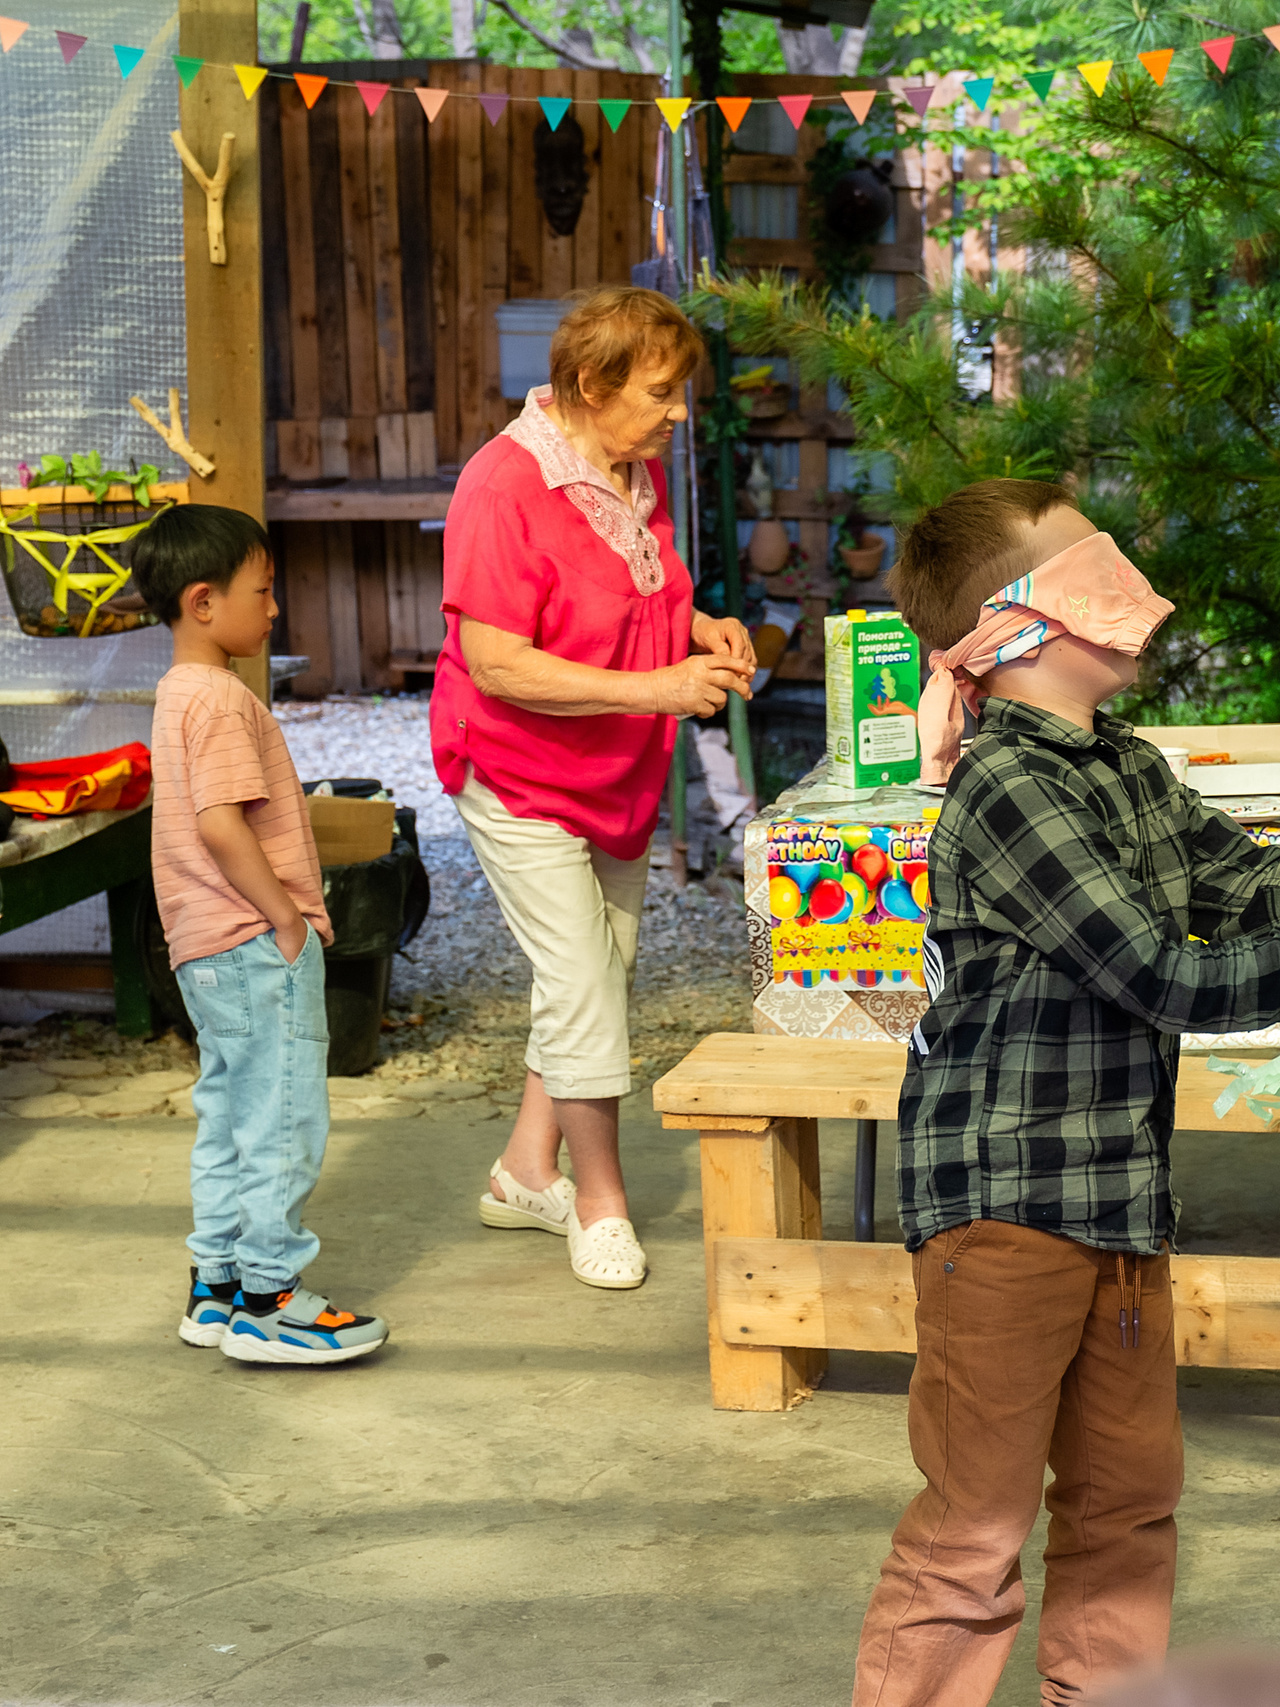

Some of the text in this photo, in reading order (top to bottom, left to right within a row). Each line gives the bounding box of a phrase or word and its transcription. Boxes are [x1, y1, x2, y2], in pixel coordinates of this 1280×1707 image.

[858, 631, 905, 642] Помогать
[858, 642, 901, 655] природе
[858, 652, 911, 665] это просто
